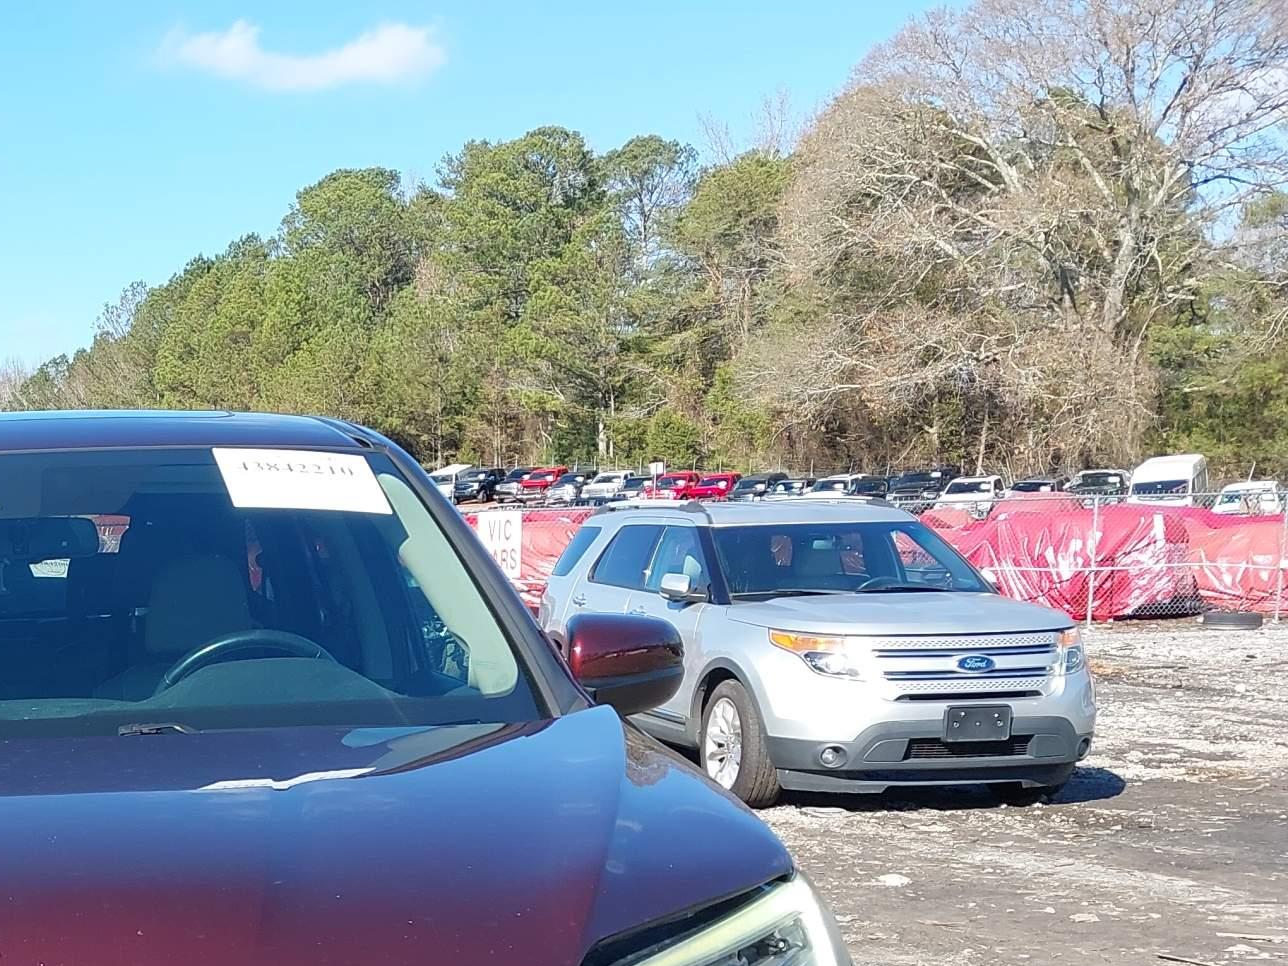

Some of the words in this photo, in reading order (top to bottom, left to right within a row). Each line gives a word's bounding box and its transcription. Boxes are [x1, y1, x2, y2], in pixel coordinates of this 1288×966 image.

[488, 519, 512, 541] VIC
[493, 548, 517, 570] ARS
[964, 657, 988, 668] Ford
